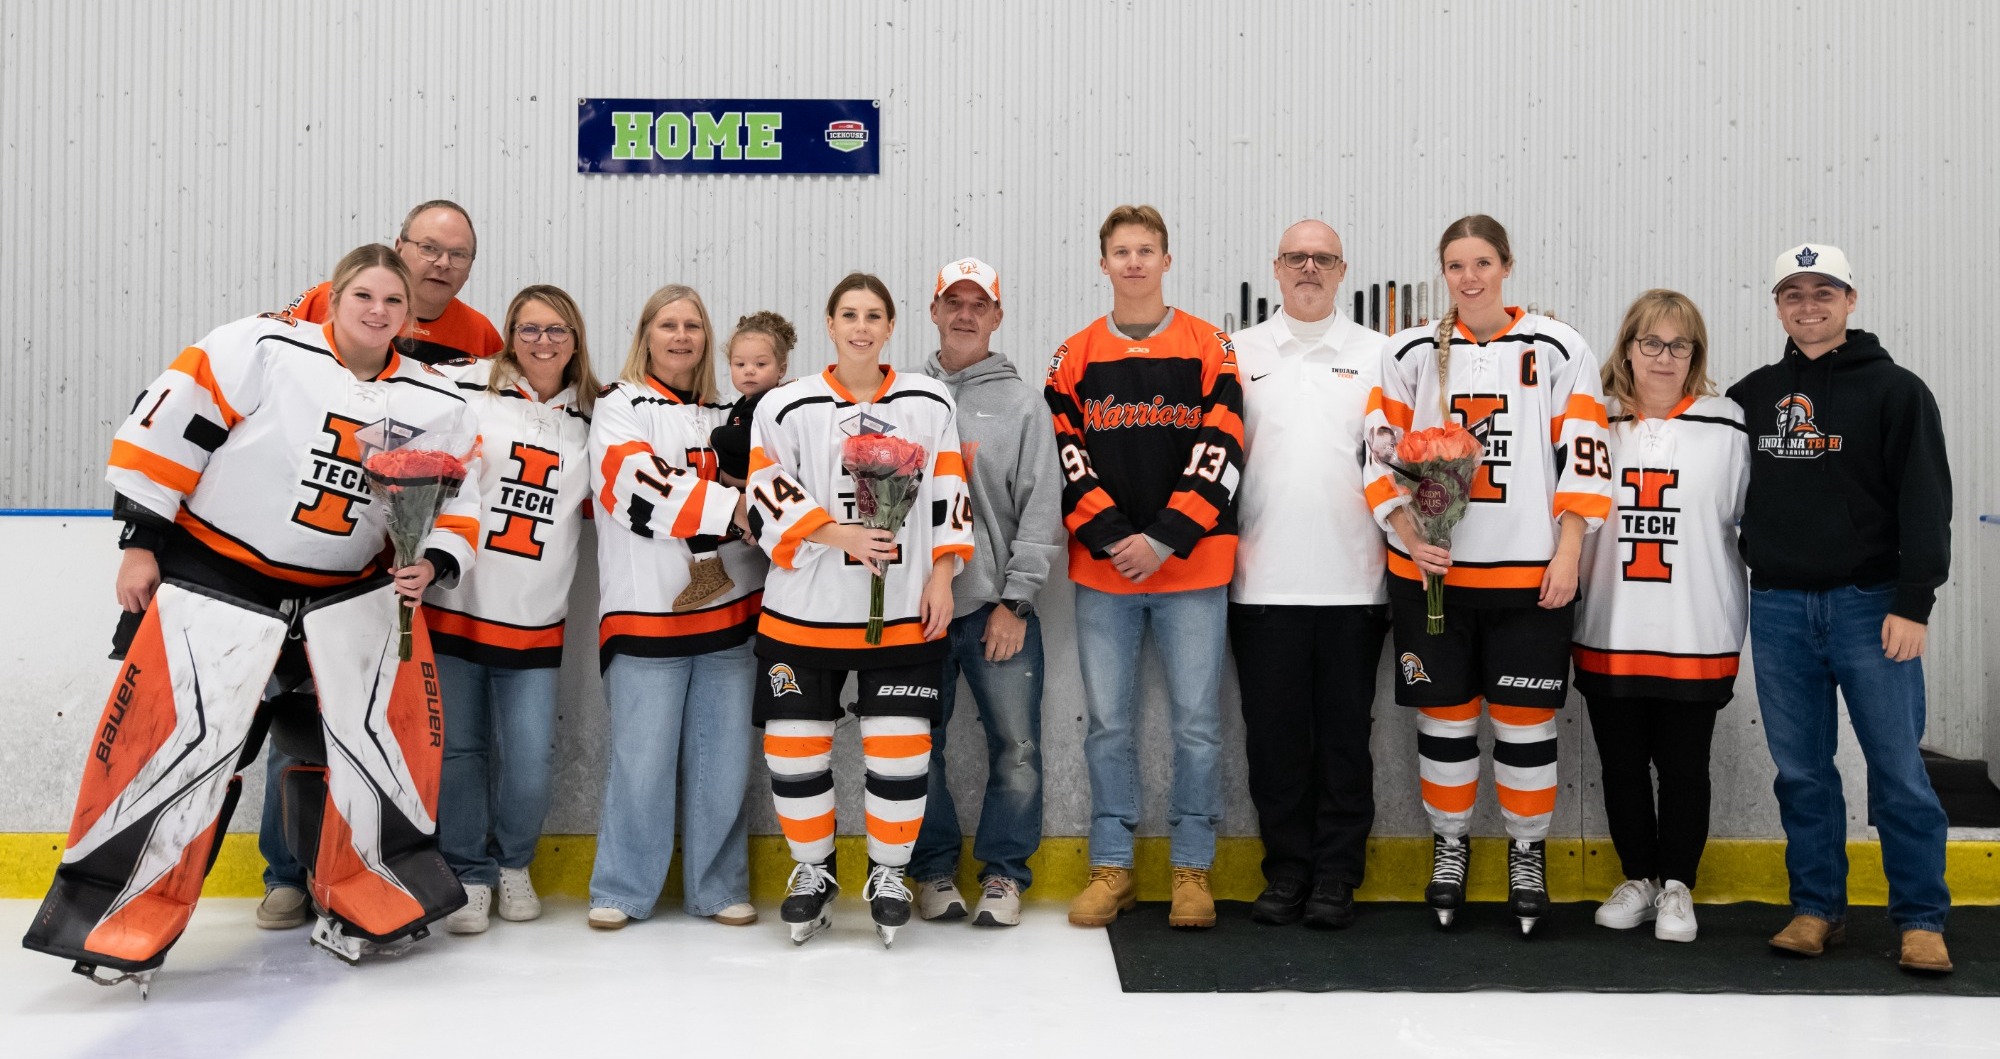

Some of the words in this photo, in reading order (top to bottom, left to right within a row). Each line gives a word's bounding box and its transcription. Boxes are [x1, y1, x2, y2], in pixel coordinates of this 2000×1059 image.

[612, 112, 782, 160] HOME
[1519, 349, 1538, 388] C
[1084, 394, 1202, 434] Warriors
[313, 459, 371, 495] TECH
[634, 455, 687, 499] 14
[1574, 436, 1612, 480] 93
[500, 486, 554, 515] TECH
[753, 476, 805, 521] 14
[951, 491, 975, 533] 14
[1621, 515, 1676, 535] TECH
[876, 685, 939, 701] BAUER
[1496, 675, 1563, 691] BAUER
[96, 663, 142, 763] BAUER
[421, 661, 441, 748] BAUER
